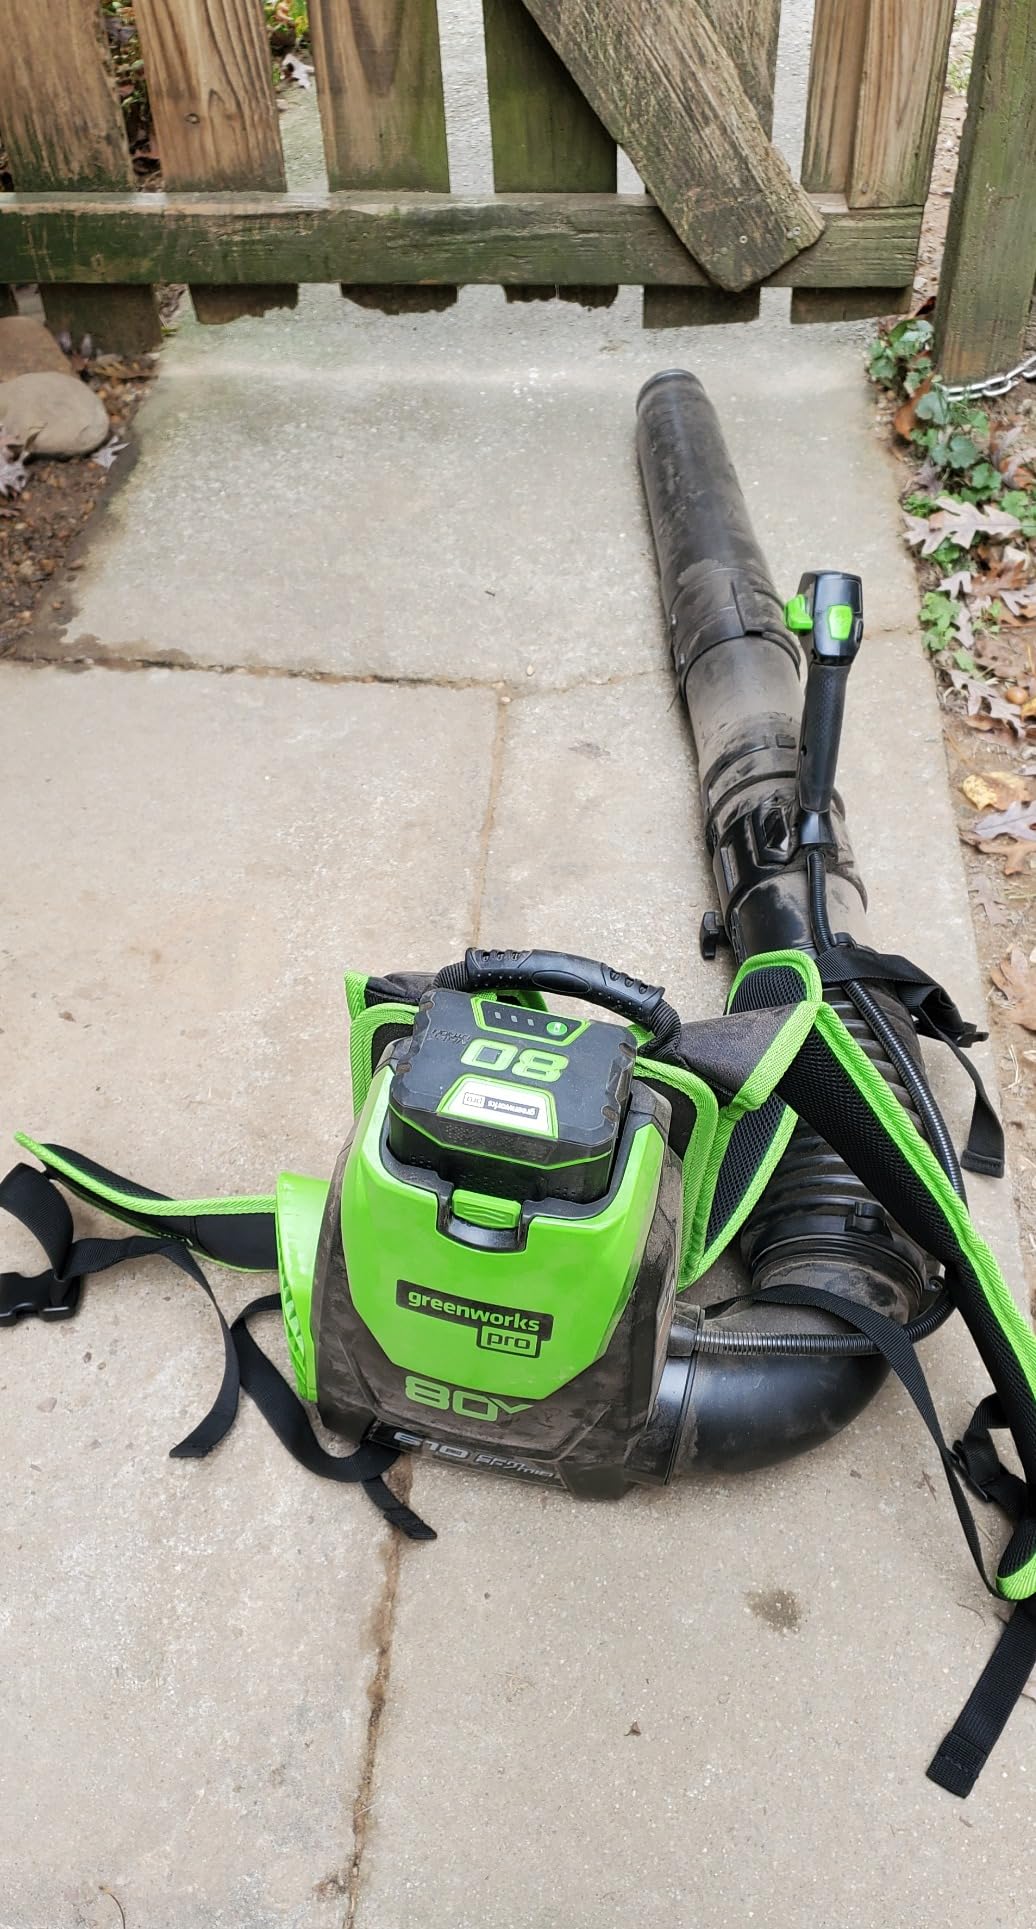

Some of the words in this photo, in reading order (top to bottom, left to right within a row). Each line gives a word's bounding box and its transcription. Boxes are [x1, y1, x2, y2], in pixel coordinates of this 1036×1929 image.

[460, 1037, 570, 1083] 80
[408, 1290, 540, 1332] greenworks
[487, 1333, 531, 1350] pro
[405, 1375, 535, 1422] 80V
[393, 1431, 469, 1459] 610
